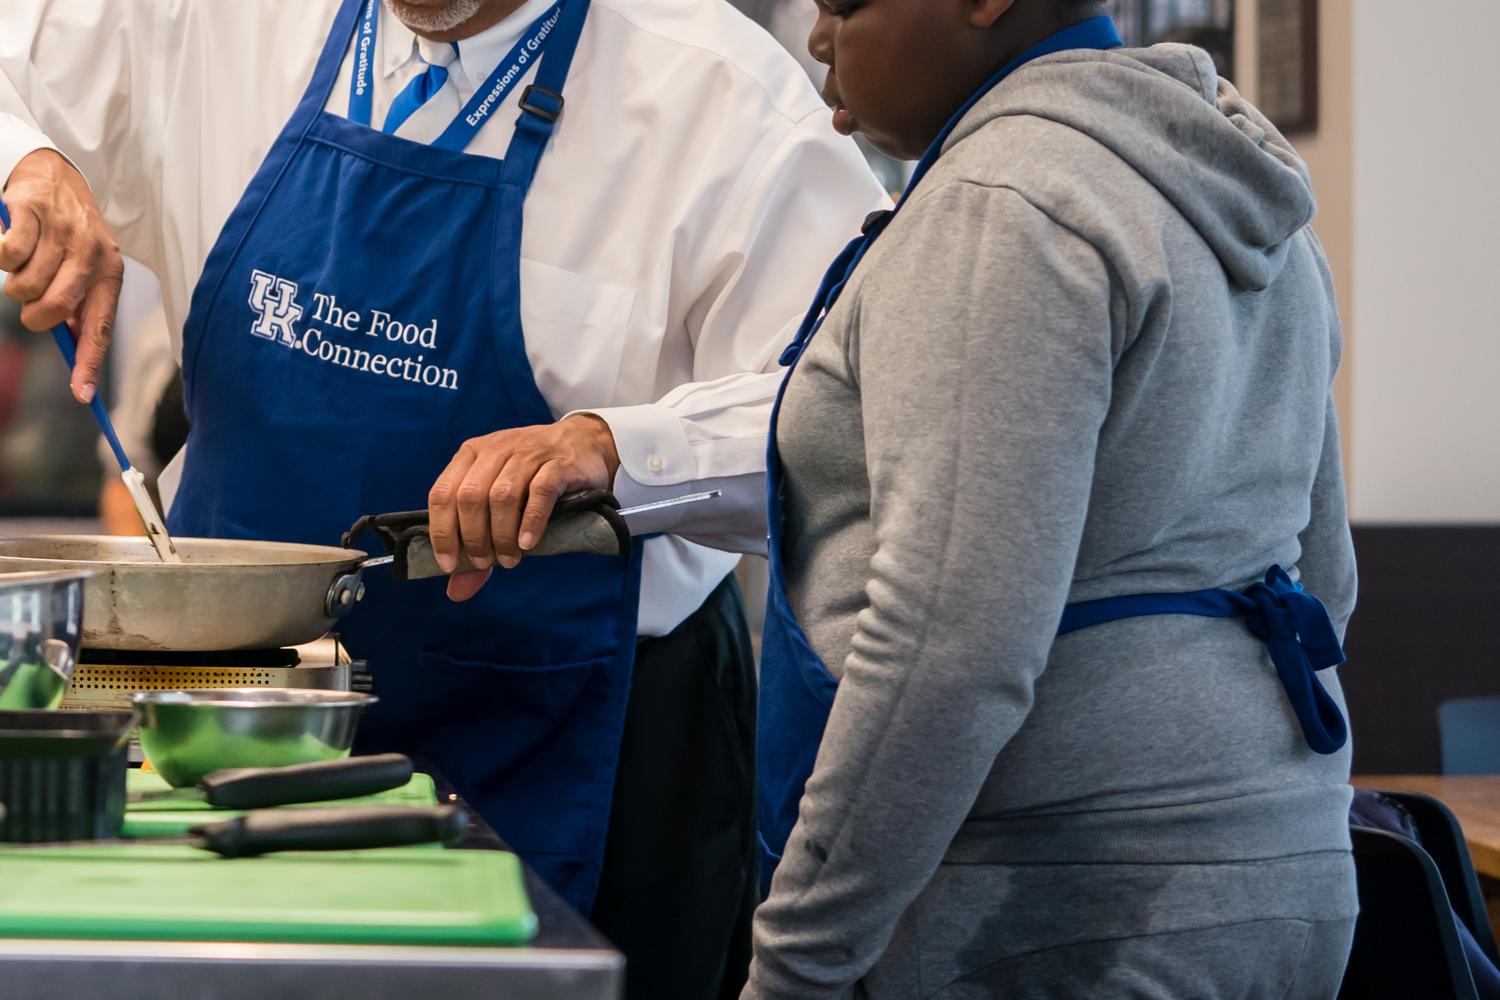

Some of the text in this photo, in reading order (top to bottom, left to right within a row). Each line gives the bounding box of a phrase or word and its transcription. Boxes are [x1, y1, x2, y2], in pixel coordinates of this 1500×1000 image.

[363, 21, 373, 35] of
[355, 36, 372, 96] Gratitude
[465, 6, 562, 127] Expressions of Gratitud
[248, 268, 304, 349] UK
[311, 292, 438, 349] The Food
[301, 328, 459, 390] Connection
